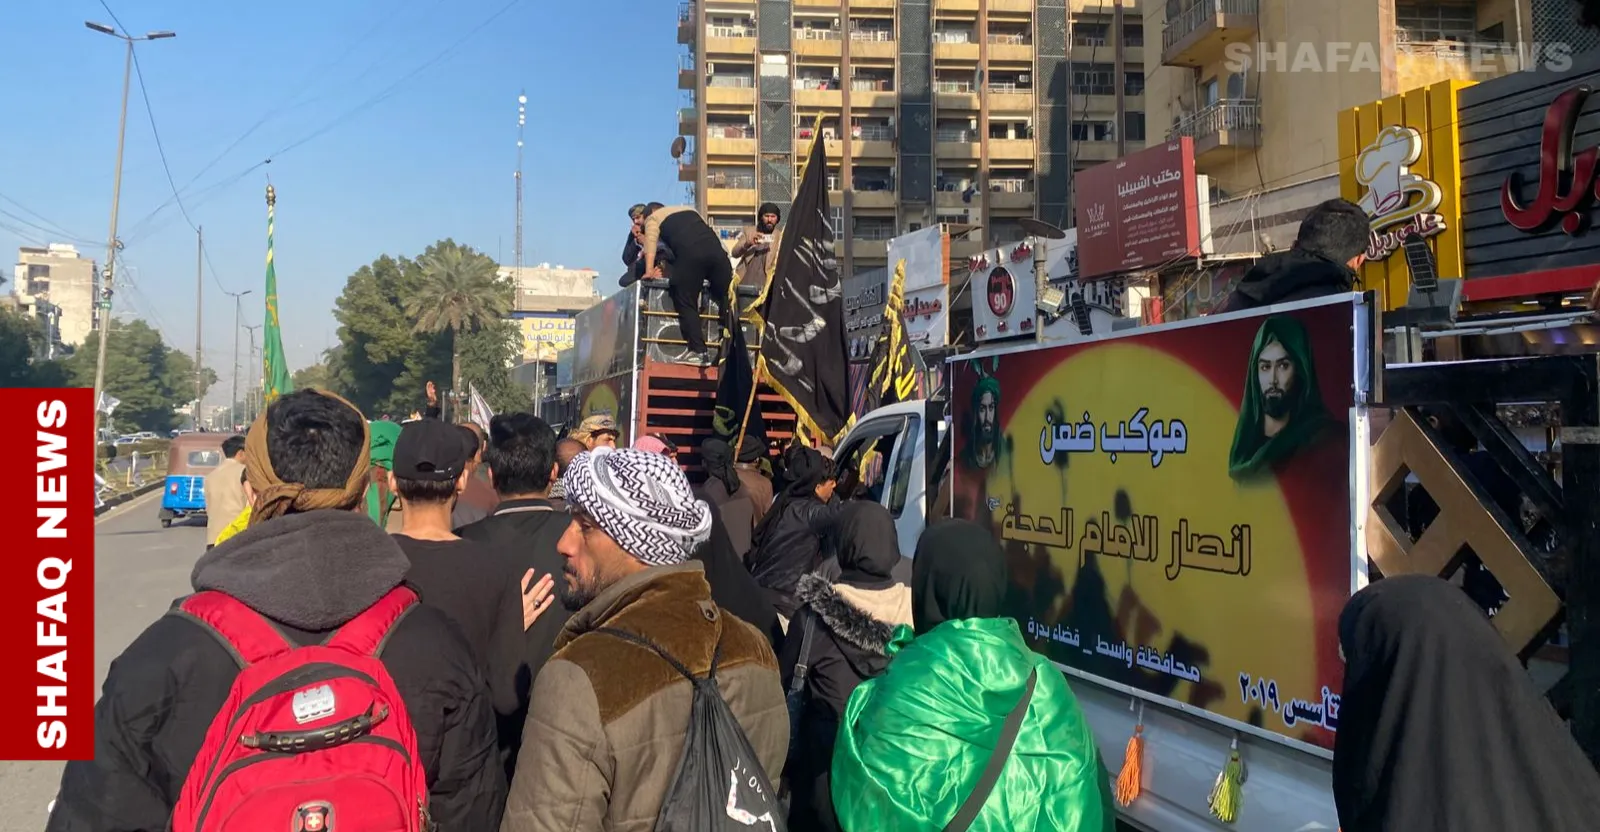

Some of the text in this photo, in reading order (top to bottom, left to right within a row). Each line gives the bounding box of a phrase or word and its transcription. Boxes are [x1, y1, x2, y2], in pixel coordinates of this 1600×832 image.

[1118, 169, 1181, 198] مكتب اشبيليا
[994, 293, 1007, 310] 90
[1100, 407, 1188, 468] موكب
[1001, 503, 1251, 580] انصار الامام الحجة
[1027, 616, 1050, 643] بدرة
[1052, 624, 1080, 647] قضاء
[1095, 634, 1133, 669] واسط
[1136, 646, 1201, 683] محافظة
[1239, 671, 1280, 713] ٢٠١٩
